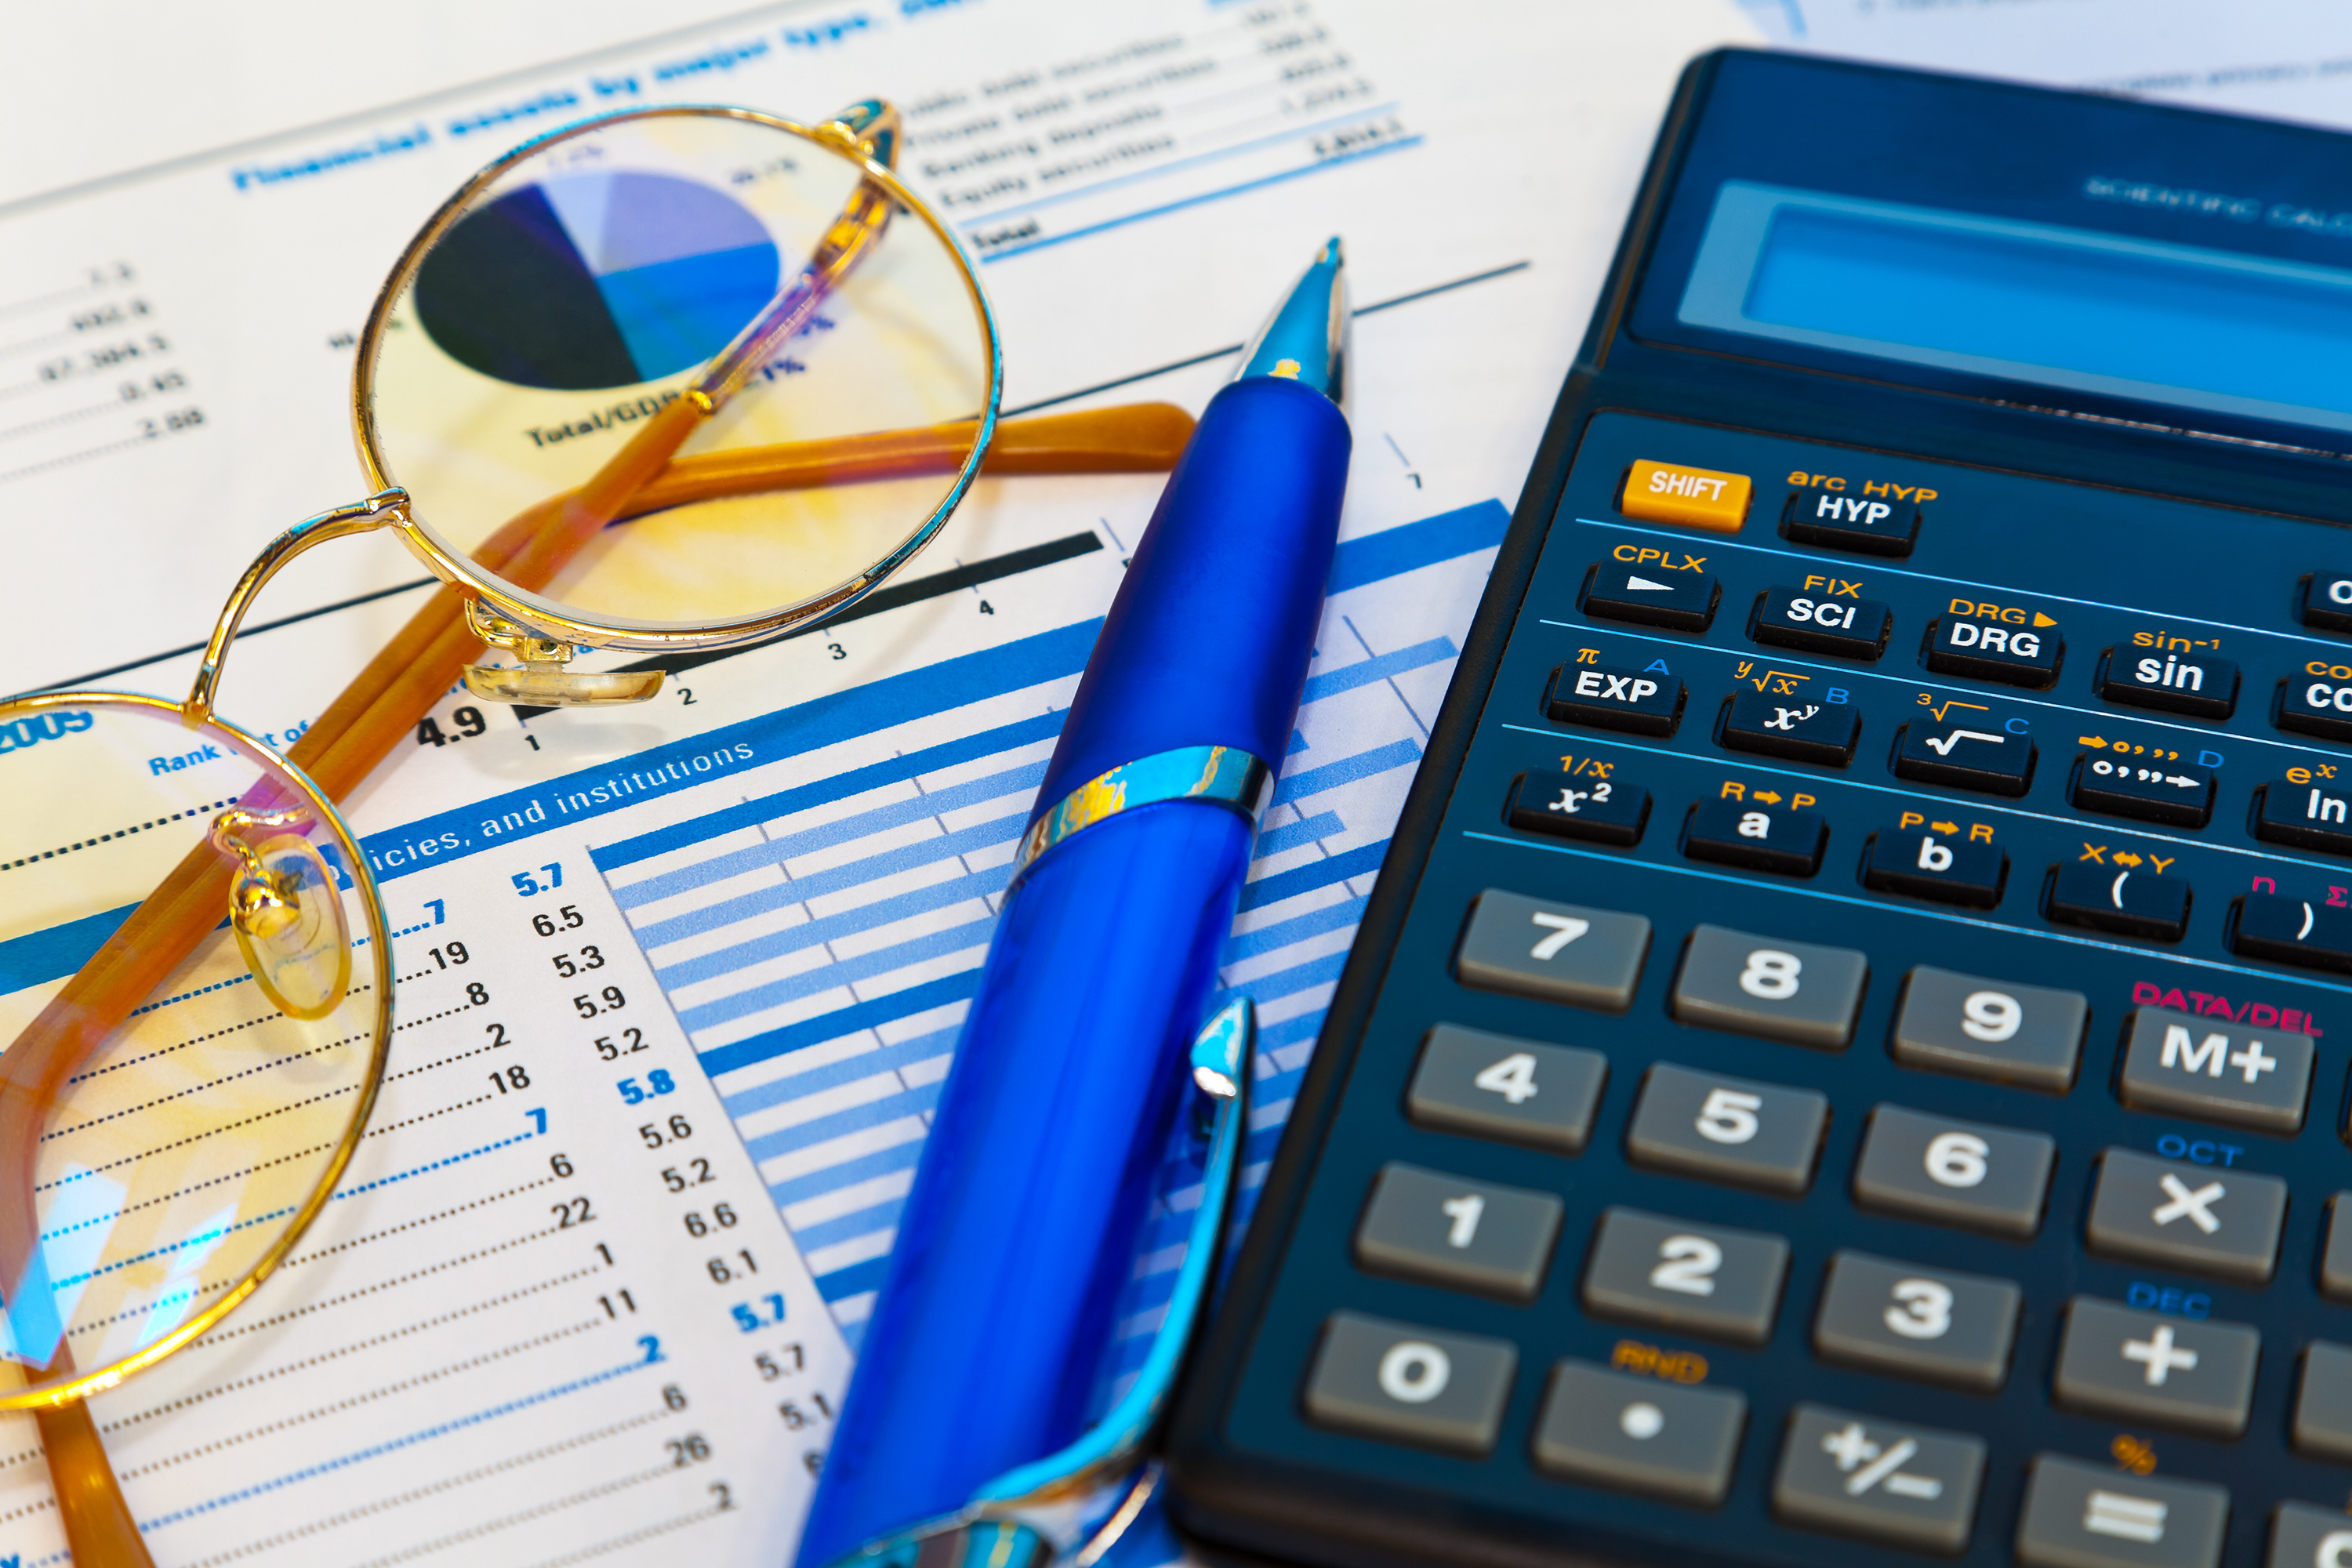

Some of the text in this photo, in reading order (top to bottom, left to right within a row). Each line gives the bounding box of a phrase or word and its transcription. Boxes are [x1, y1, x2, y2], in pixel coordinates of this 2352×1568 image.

[1648, 470, 1728, 502] SHIFT
[1787, 470, 1939, 504] arc HYP
[1816, 495, 1891, 525] HYP
[1613, 544, 1708, 573] CPLX
[980, 599, 995, 615] 4
[1804, 574, 1864, 598] FIX
[1787, 598, 1857, 630] SCI
[1949, 598, 2027, 625] DRG
[827, 643, 848, 661] 3
[1950, 622, 2042, 658] DRG
[1575, 670, 1658, 702] EXP
[1643, 659, 1671, 675] A
[2135, 655, 2204, 691] sin
[676, 687, 699, 706] 2
[1826, 687, 1849, 705] B
[416, 706, 488, 749] 4.9
[524, 735, 541, 753] 1
[2005, 718, 2030, 735] C
[147, 744, 221, 776] Rank
[1560, 755, 1614, 779] 1/x
[2198, 750, 2225, 768] D
[372, 739, 755, 872] icies, and institutions
[1737, 811, 1771, 840] a
[1918, 837, 1954, 873] b
[423, 862, 562, 925] 7 5.7
[429, 904, 584, 971] 19 6.5
[1530, 909, 1590, 961] 7
[467, 945, 605, 1006] 8 5.3
[1739, 948, 1803, 1001] 8
[487, 985, 626, 1048] 2 5.9
[1962, 990, 2023, 1043] 9
[2132, 981, 2323, 1037] DATA/DEL
[489, 1027, 649, 1095] 18 5.2
[2160, 1025, 2277, 1084] M+
[525, 1068, 676, 1135] 7 5.8
[1475, 1053, 1538, 1104] 4
[1694, 1087, 1762, 1145] 5
[550, 1114, 692, 1179] 6 5.6
[1924, 1131, 1991, 1189] 6
[2156, 1134, 2245, 1168] OCT
[551, 1157, 717, 1231] 22 5.2
[594, 1202, 738, 1268] 1 6.6
[1443, 1193, 1484, 1248] 1
[597, 1248, 760, 1321] 11 6.1
[1650, 1233, 1723, 1298] 2
[1884, 1276, 1955, 1340] 3
[2126, 1280, 2212, 1320] DEC
[637, 1292, 787, 1363] 2 5.7
[662, 1341, 806, 1413] 6 5.7
[1377, 1339, 1453, 1404] 0
[1611, 1338, 1710, 1385] RND
[665, 1392, 835, 1468] 26 5.1
[710, 1481, 737, 1512] 2
